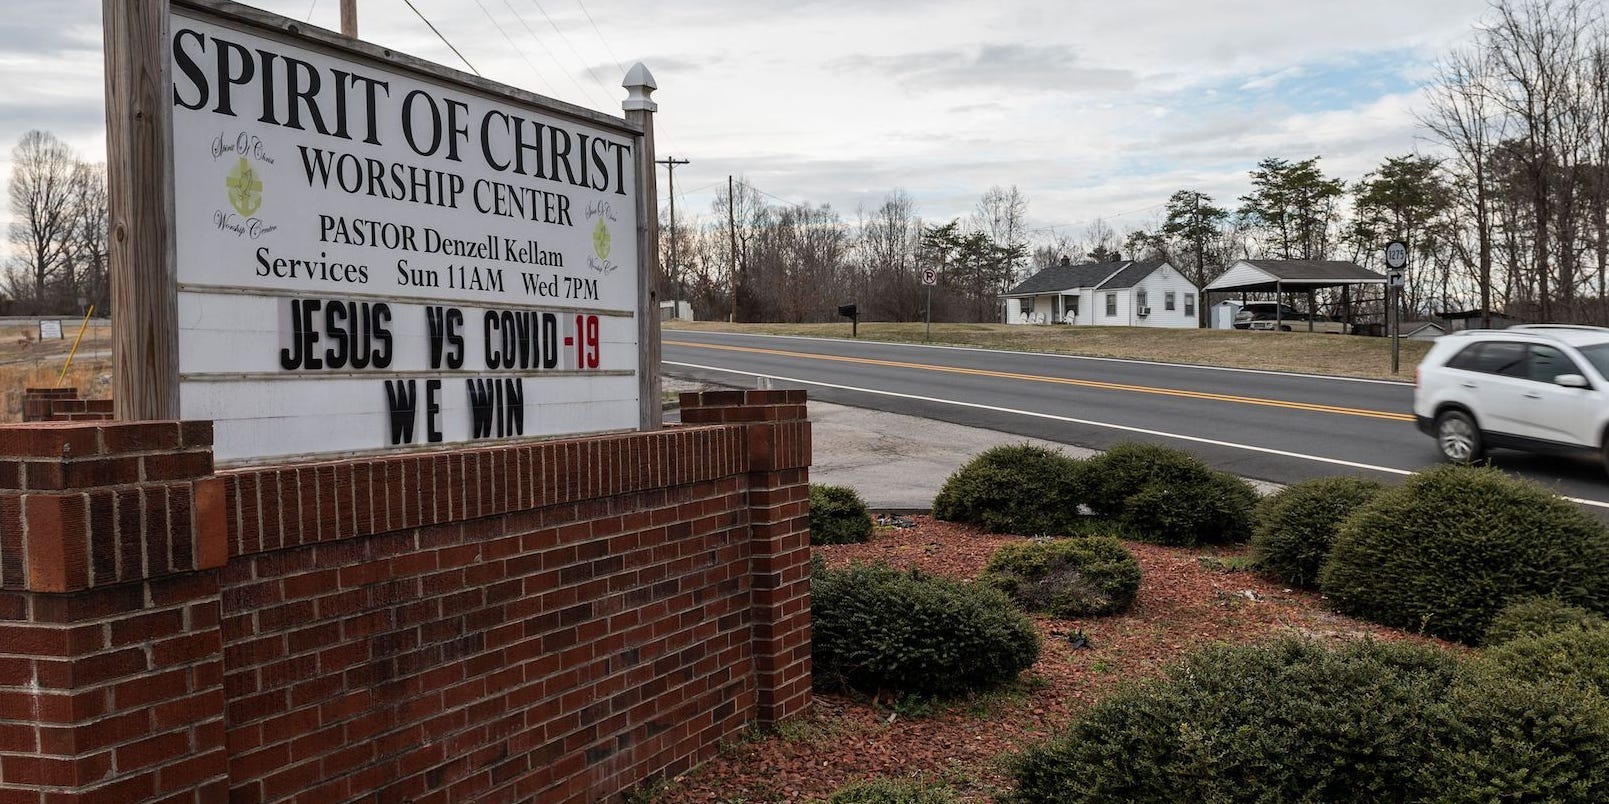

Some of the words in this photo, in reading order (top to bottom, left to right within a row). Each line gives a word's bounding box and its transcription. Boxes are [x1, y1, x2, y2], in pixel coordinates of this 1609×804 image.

[173, 28, 390, 146] SPIRIT
[402, 89, 469, 162] OF
[480, 110, 631, 196] CHRIST
[297, 145, 464, 209] WORSHIP
[473, 179, 573, 227] CENTER
[256, 247, 369, 284] Services
[397, 259, 439, 288] Sun
[448, 265, 505, 293] 11AM
[521, 272, 559, 298] Wed
[563, 277, 600, 301] 7PM
[319, 214, 418, 251] PASTOR
[424, 227, 500, 261] Denzell
[504, 238, 564, 267] Kellam
[1388, 249, 1404, 260] 1275
[281, 299, 393, 370] JESUS
[427, 306, 464, 370] VS
[385, 379, 442, 445] WE
[467, 378, 525, 440] WIN
